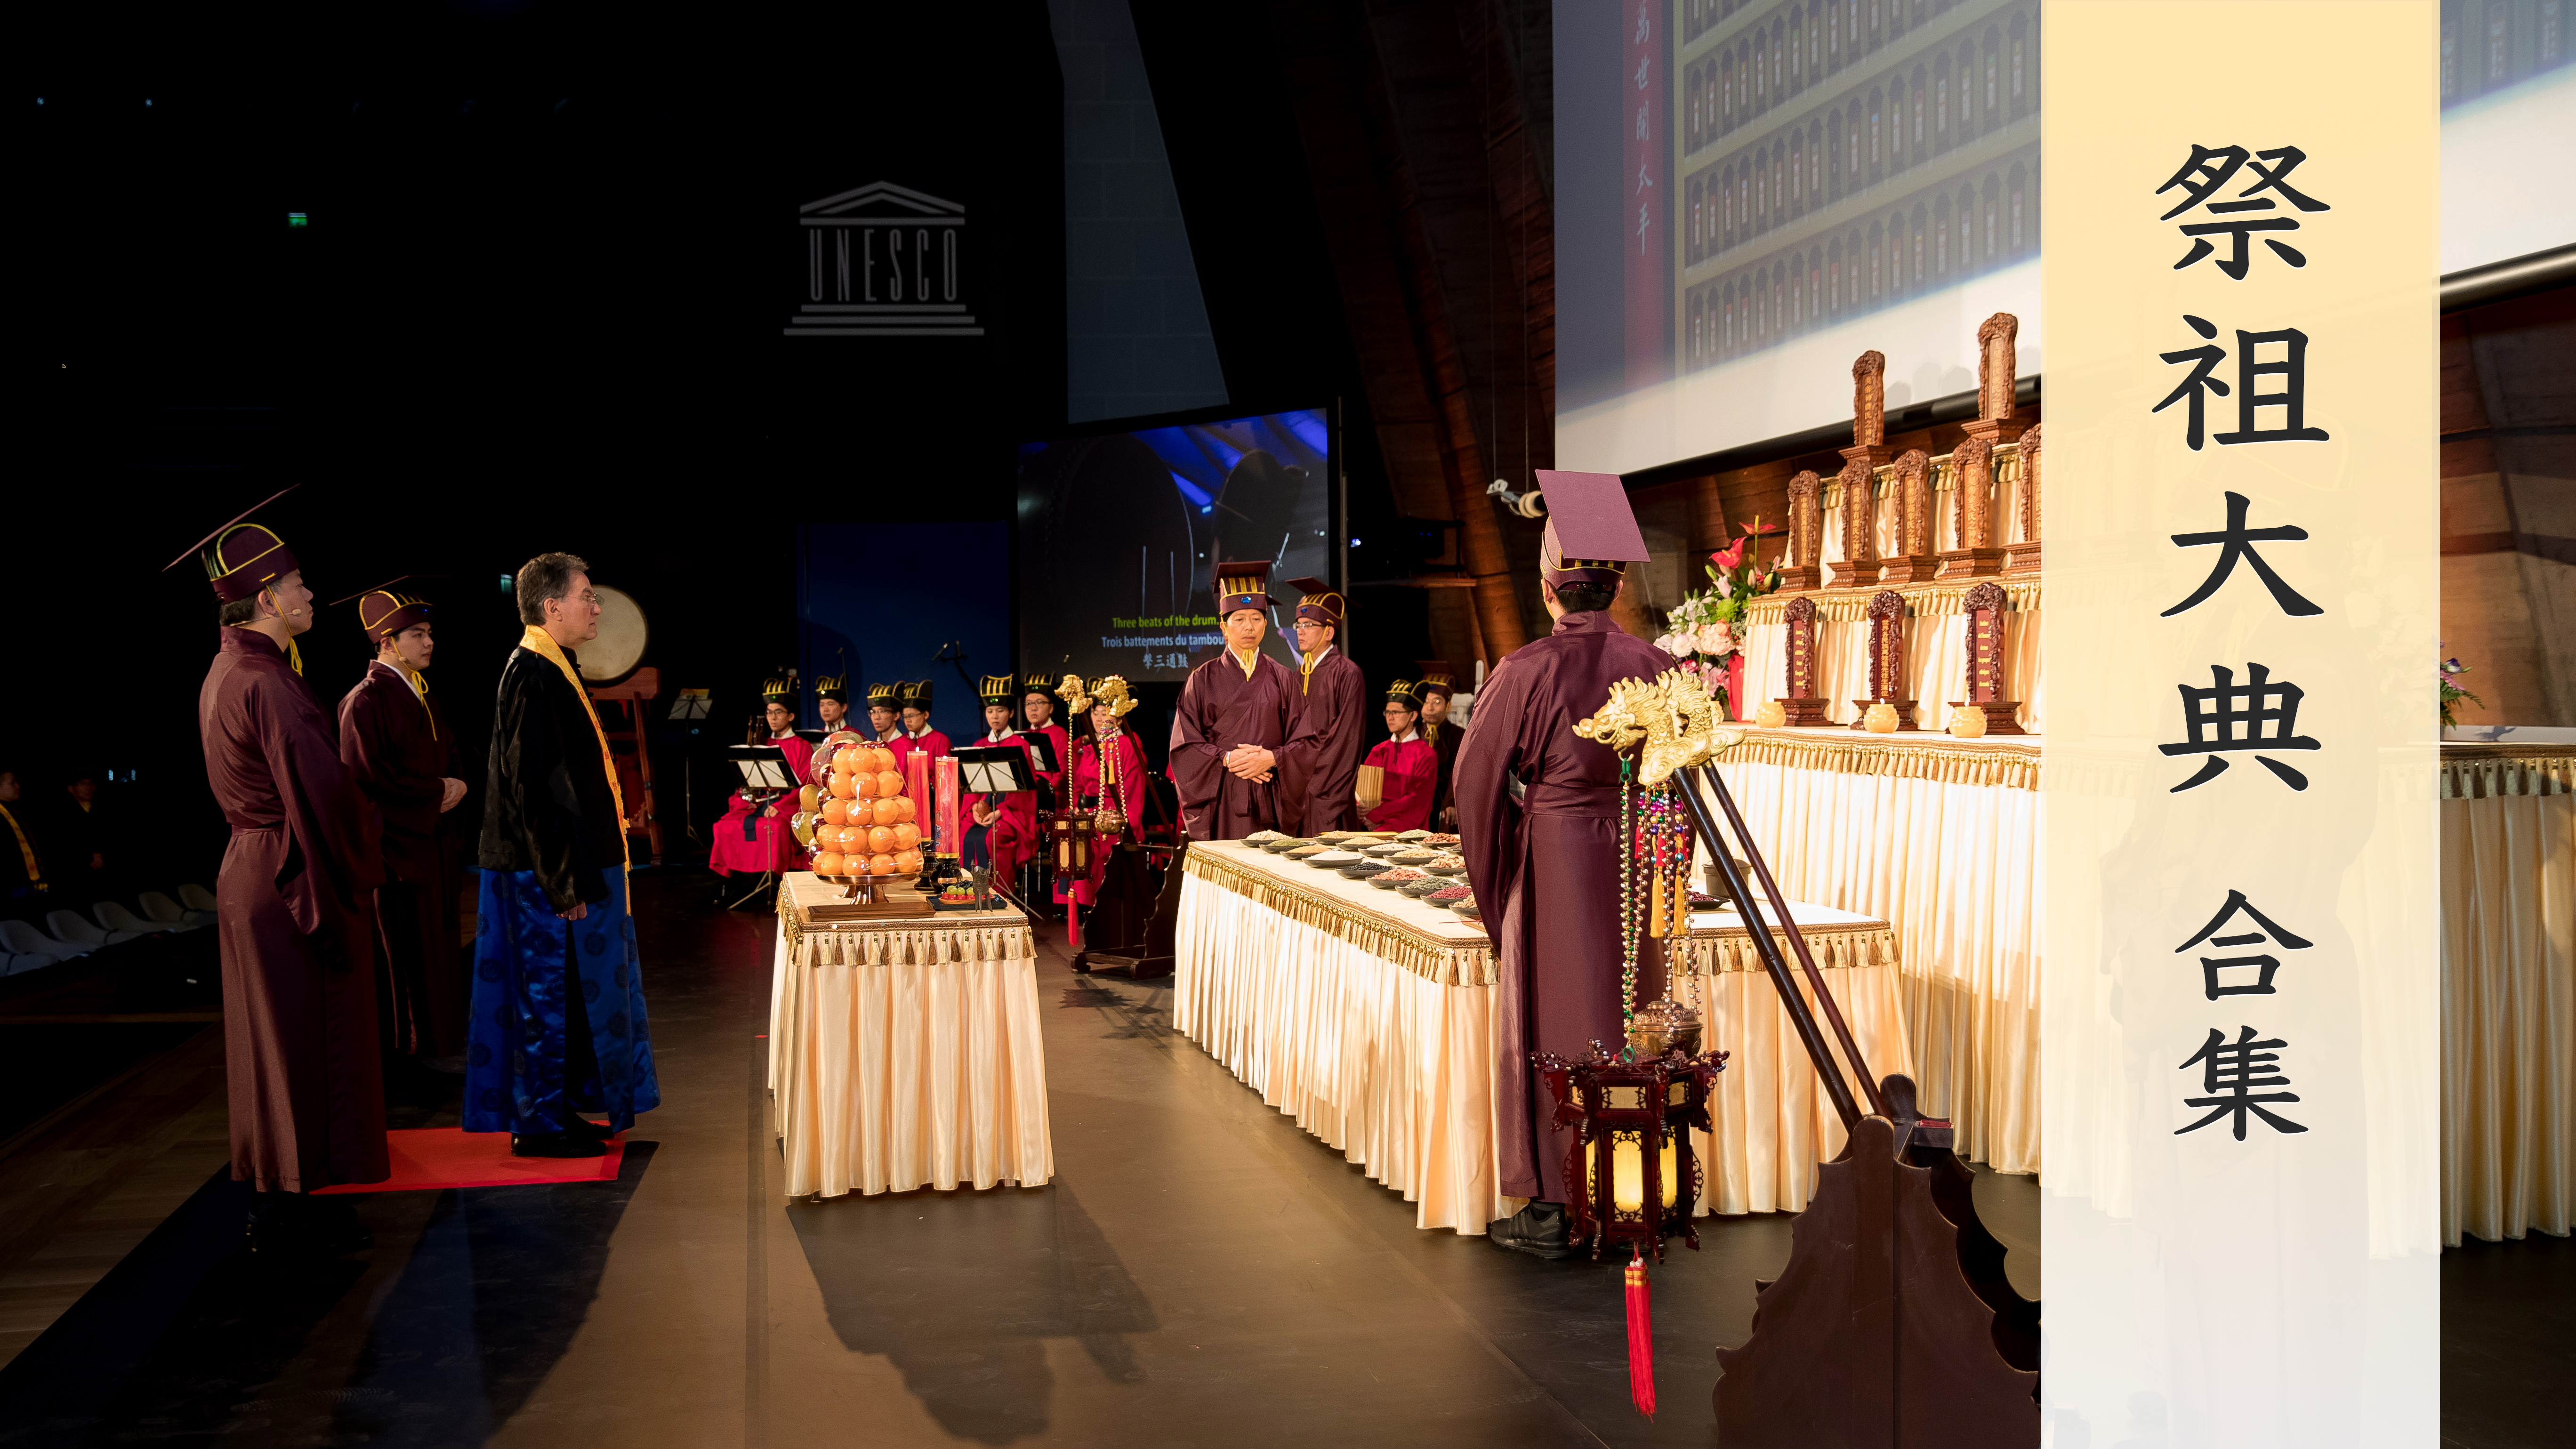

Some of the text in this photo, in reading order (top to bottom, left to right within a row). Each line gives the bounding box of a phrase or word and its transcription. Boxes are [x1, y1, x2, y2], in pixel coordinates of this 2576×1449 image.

[809, 228, 957, 302] UNESCO
[1112, 614, 1219, 628] Three beats of the drum.
[1101, 633, 1225, 647] Trois battements du tambou
